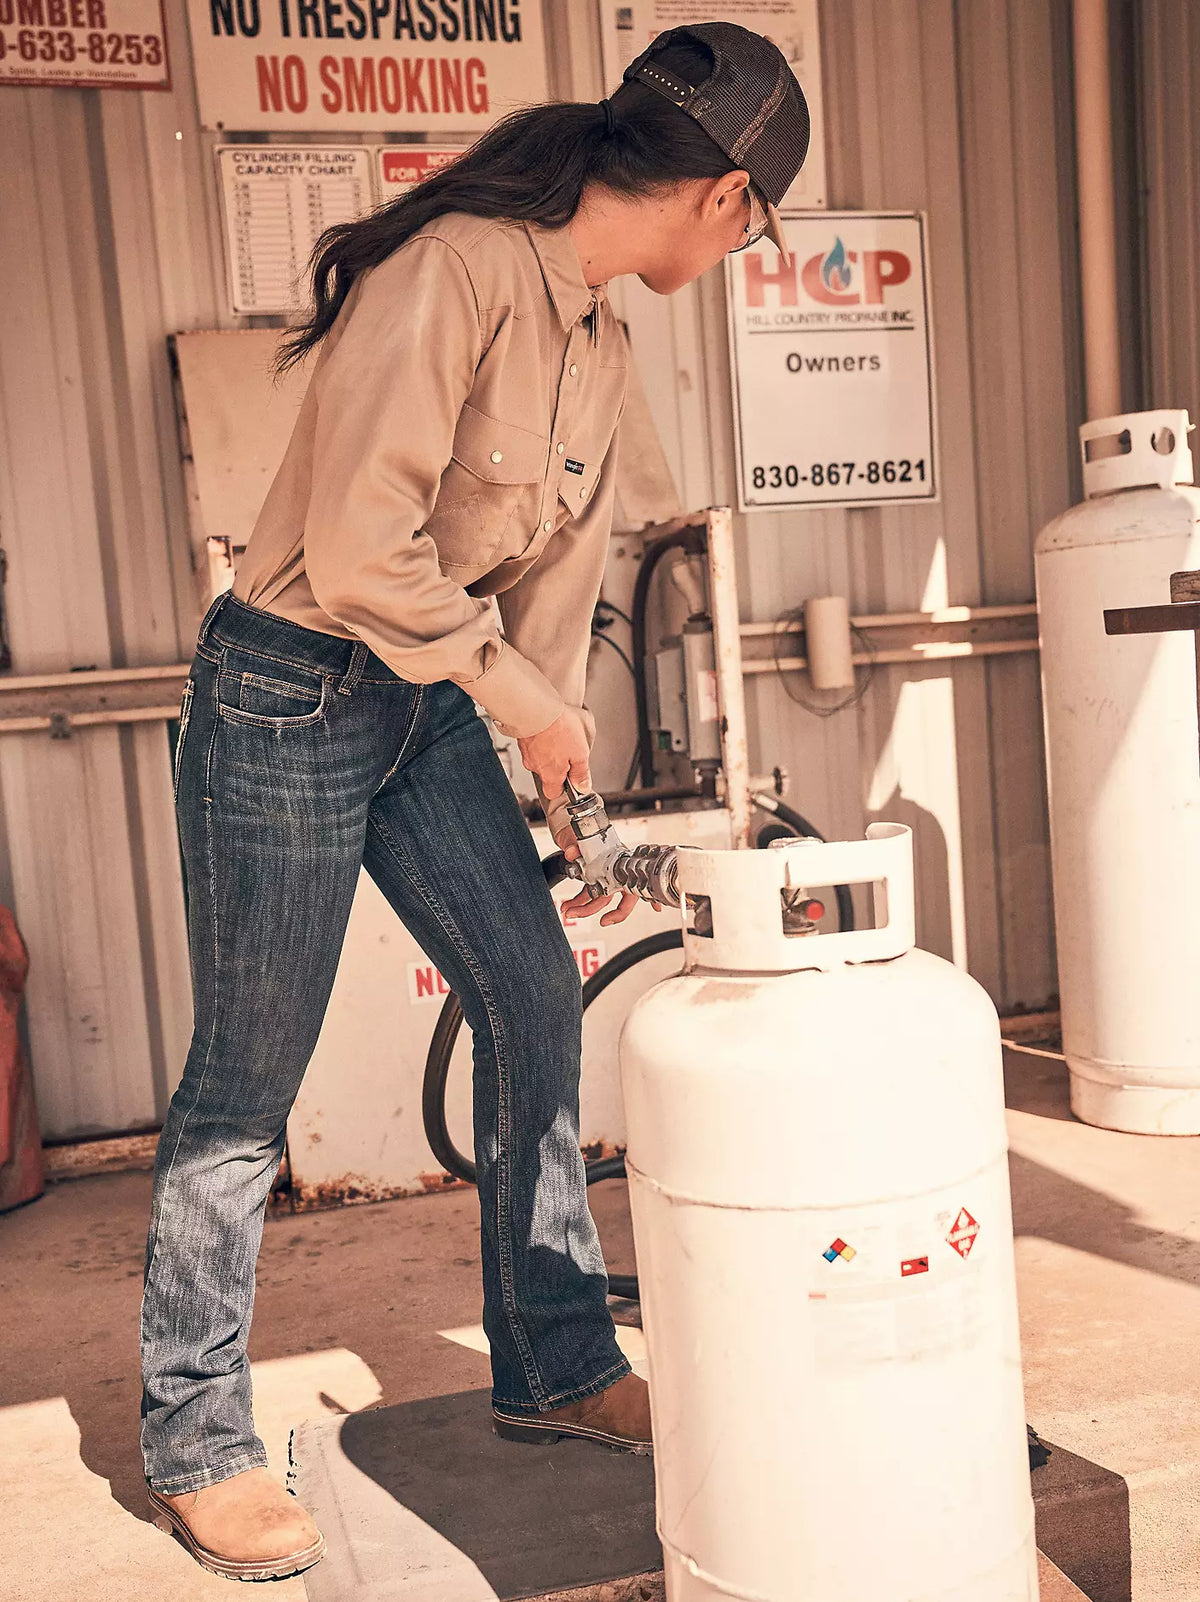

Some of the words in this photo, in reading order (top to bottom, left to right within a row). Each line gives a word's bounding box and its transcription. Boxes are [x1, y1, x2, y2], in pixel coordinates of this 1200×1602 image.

[210, 0, 261, 38] NO
[280, 0, 522, 42] TRESPASSING
[256, 55, 309, 114] NO
[319, 55, 490, 115] SMOKING
[232, 152, 301, 164] CYLINDER
[305, 153, 356, 163] FILLING
[235, 165, 303, 176] CAPACITY
[309, 165, 353, 175] CHART
[388, 167, 419, 181] FOR
[743, 250, 912, 307] HCP
[746, 315, 771, 326] HILL
[774, 313, 831, 326] COUNTRY
[834, 312, 888, 324] PROPANE
[786, 352, 881, 373] Owners
[752, 459, 926, 489] 830-867-8621
